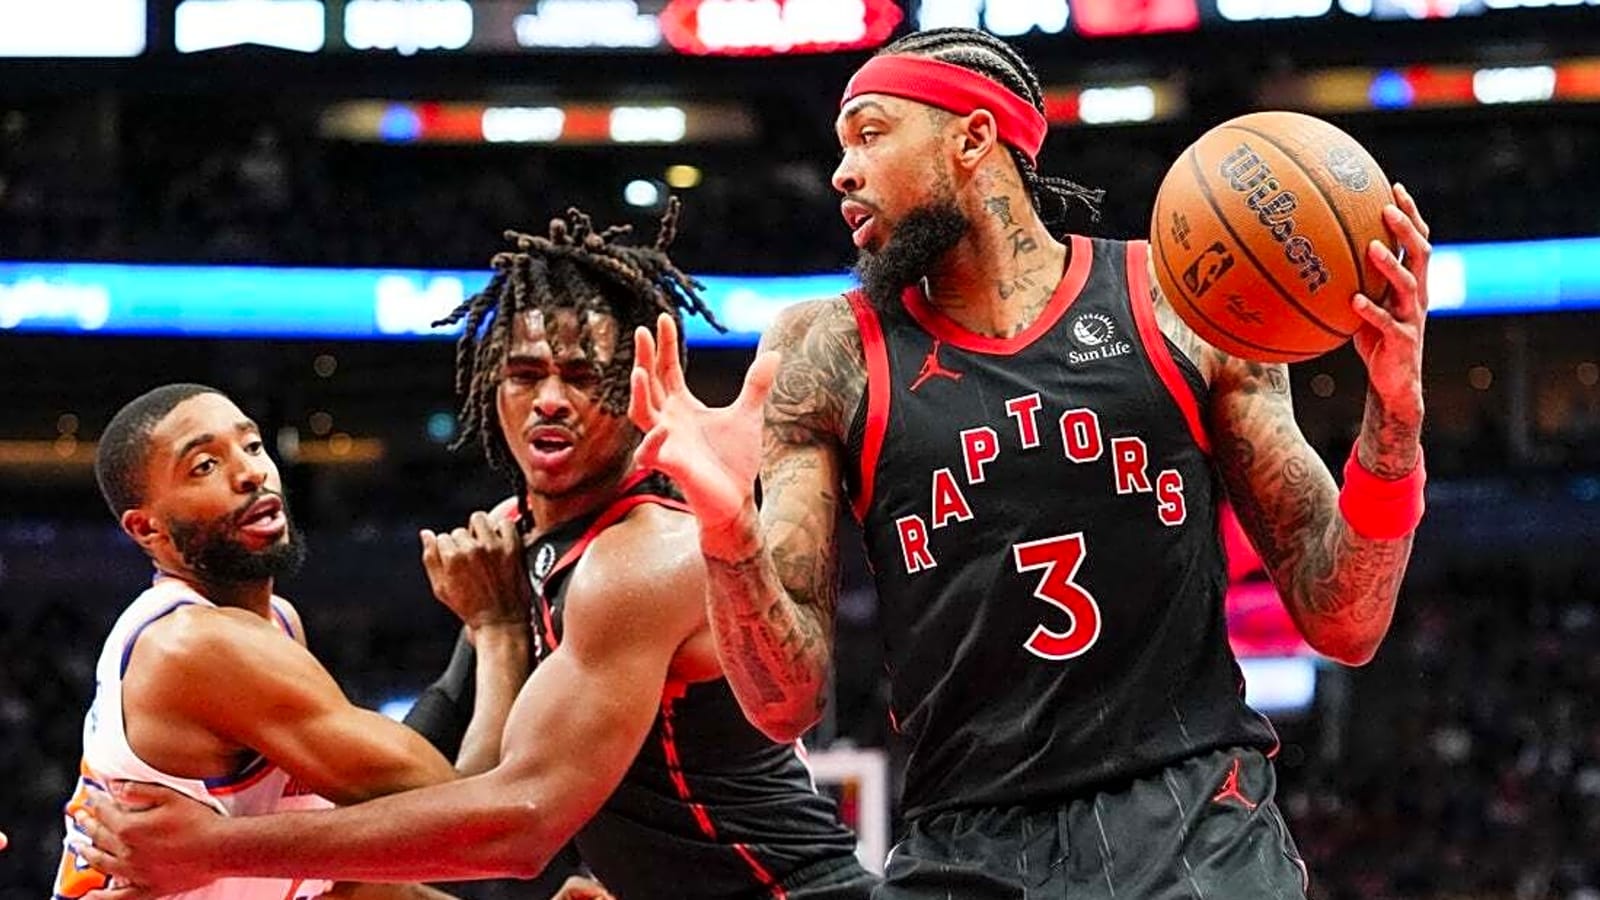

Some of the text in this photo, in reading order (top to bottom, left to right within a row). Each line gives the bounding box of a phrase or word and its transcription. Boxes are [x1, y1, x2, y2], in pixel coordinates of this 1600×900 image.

[1220, 143, 1330, 294] Wilson
[1069, 341, 1130, 364] Sun Life
[896, 393, 1186, 574] RAPTORS
[1013, 531, 1102, 661] 3
